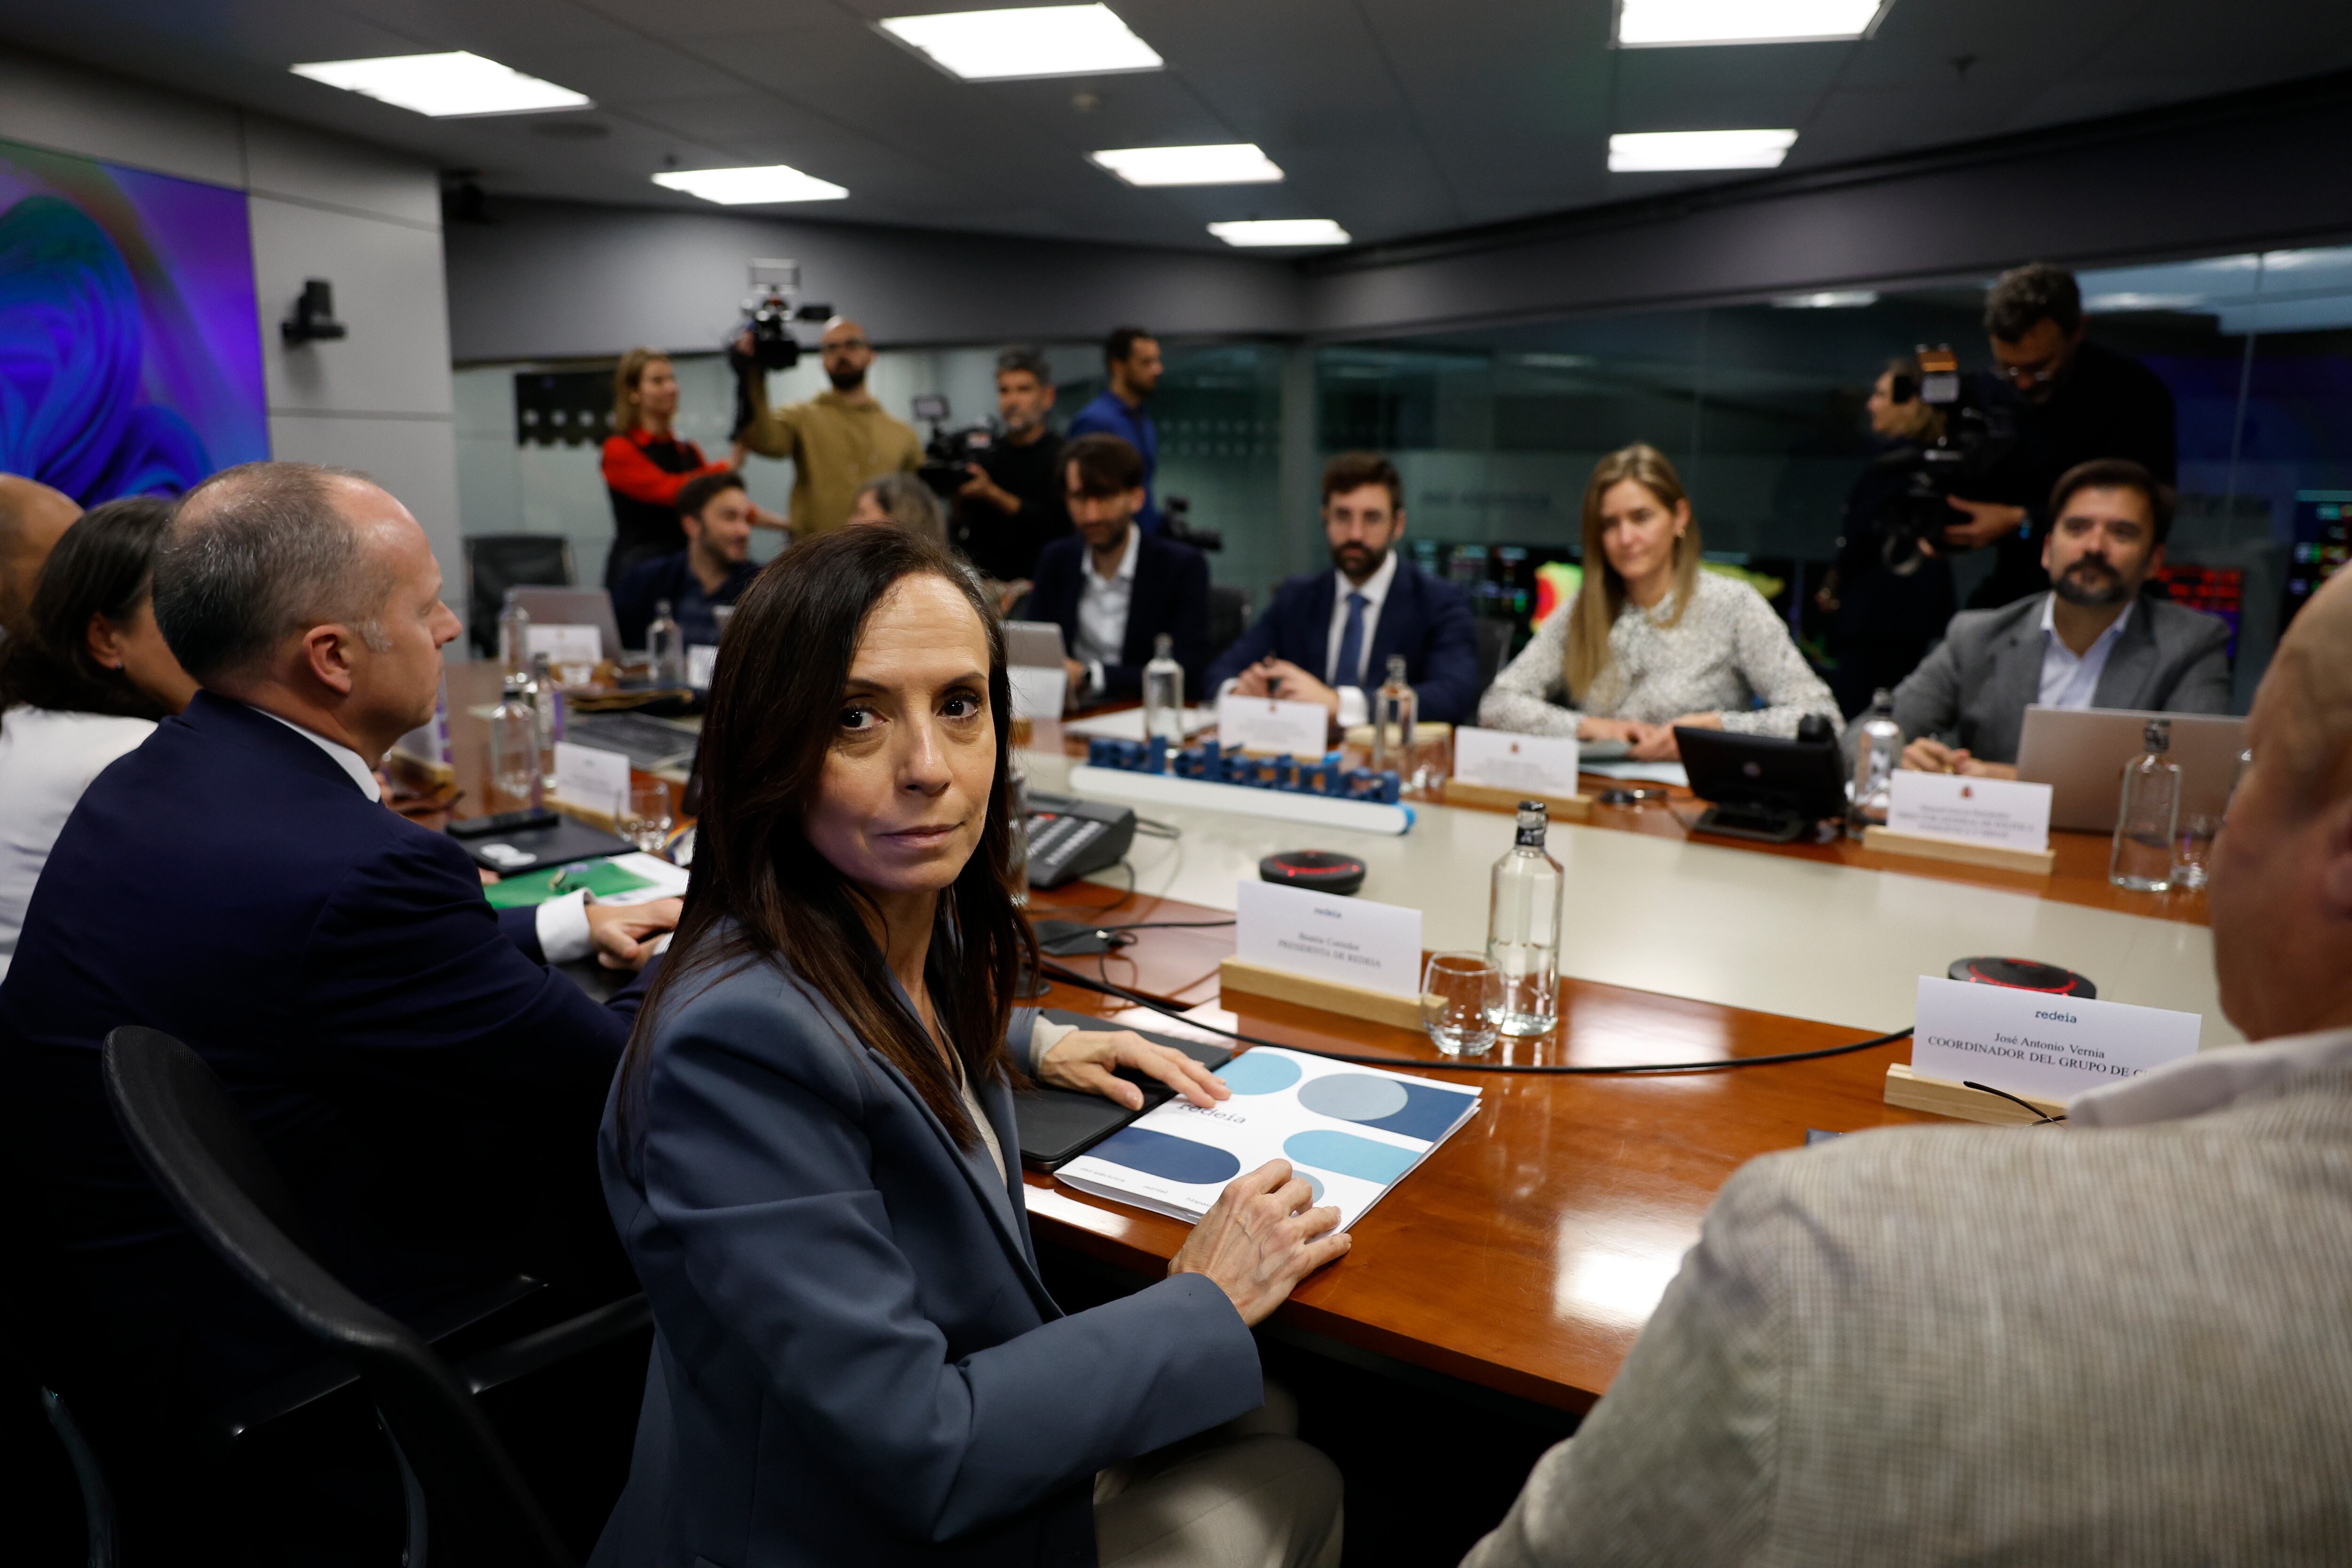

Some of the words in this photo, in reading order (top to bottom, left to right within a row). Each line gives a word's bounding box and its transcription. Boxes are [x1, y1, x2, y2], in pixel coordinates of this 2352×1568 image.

[2035, 1010, 2077, 1024] redeia
[1928, 1035, 2025, 1060] COORDINADOR
[2029, 1052, 2056, 1066] DEL
[2059, 1057, 2106, 1073] GRUPO
[2110, 1065, 2130, 1077] DE
[1994, 1033, 2018, 1045] José
[2021, 1037, 2064, 1052] Antonio
[2069, 1043, 2105, 1059] Vernia
[1177, 1103, 1246, 1123] redeia
